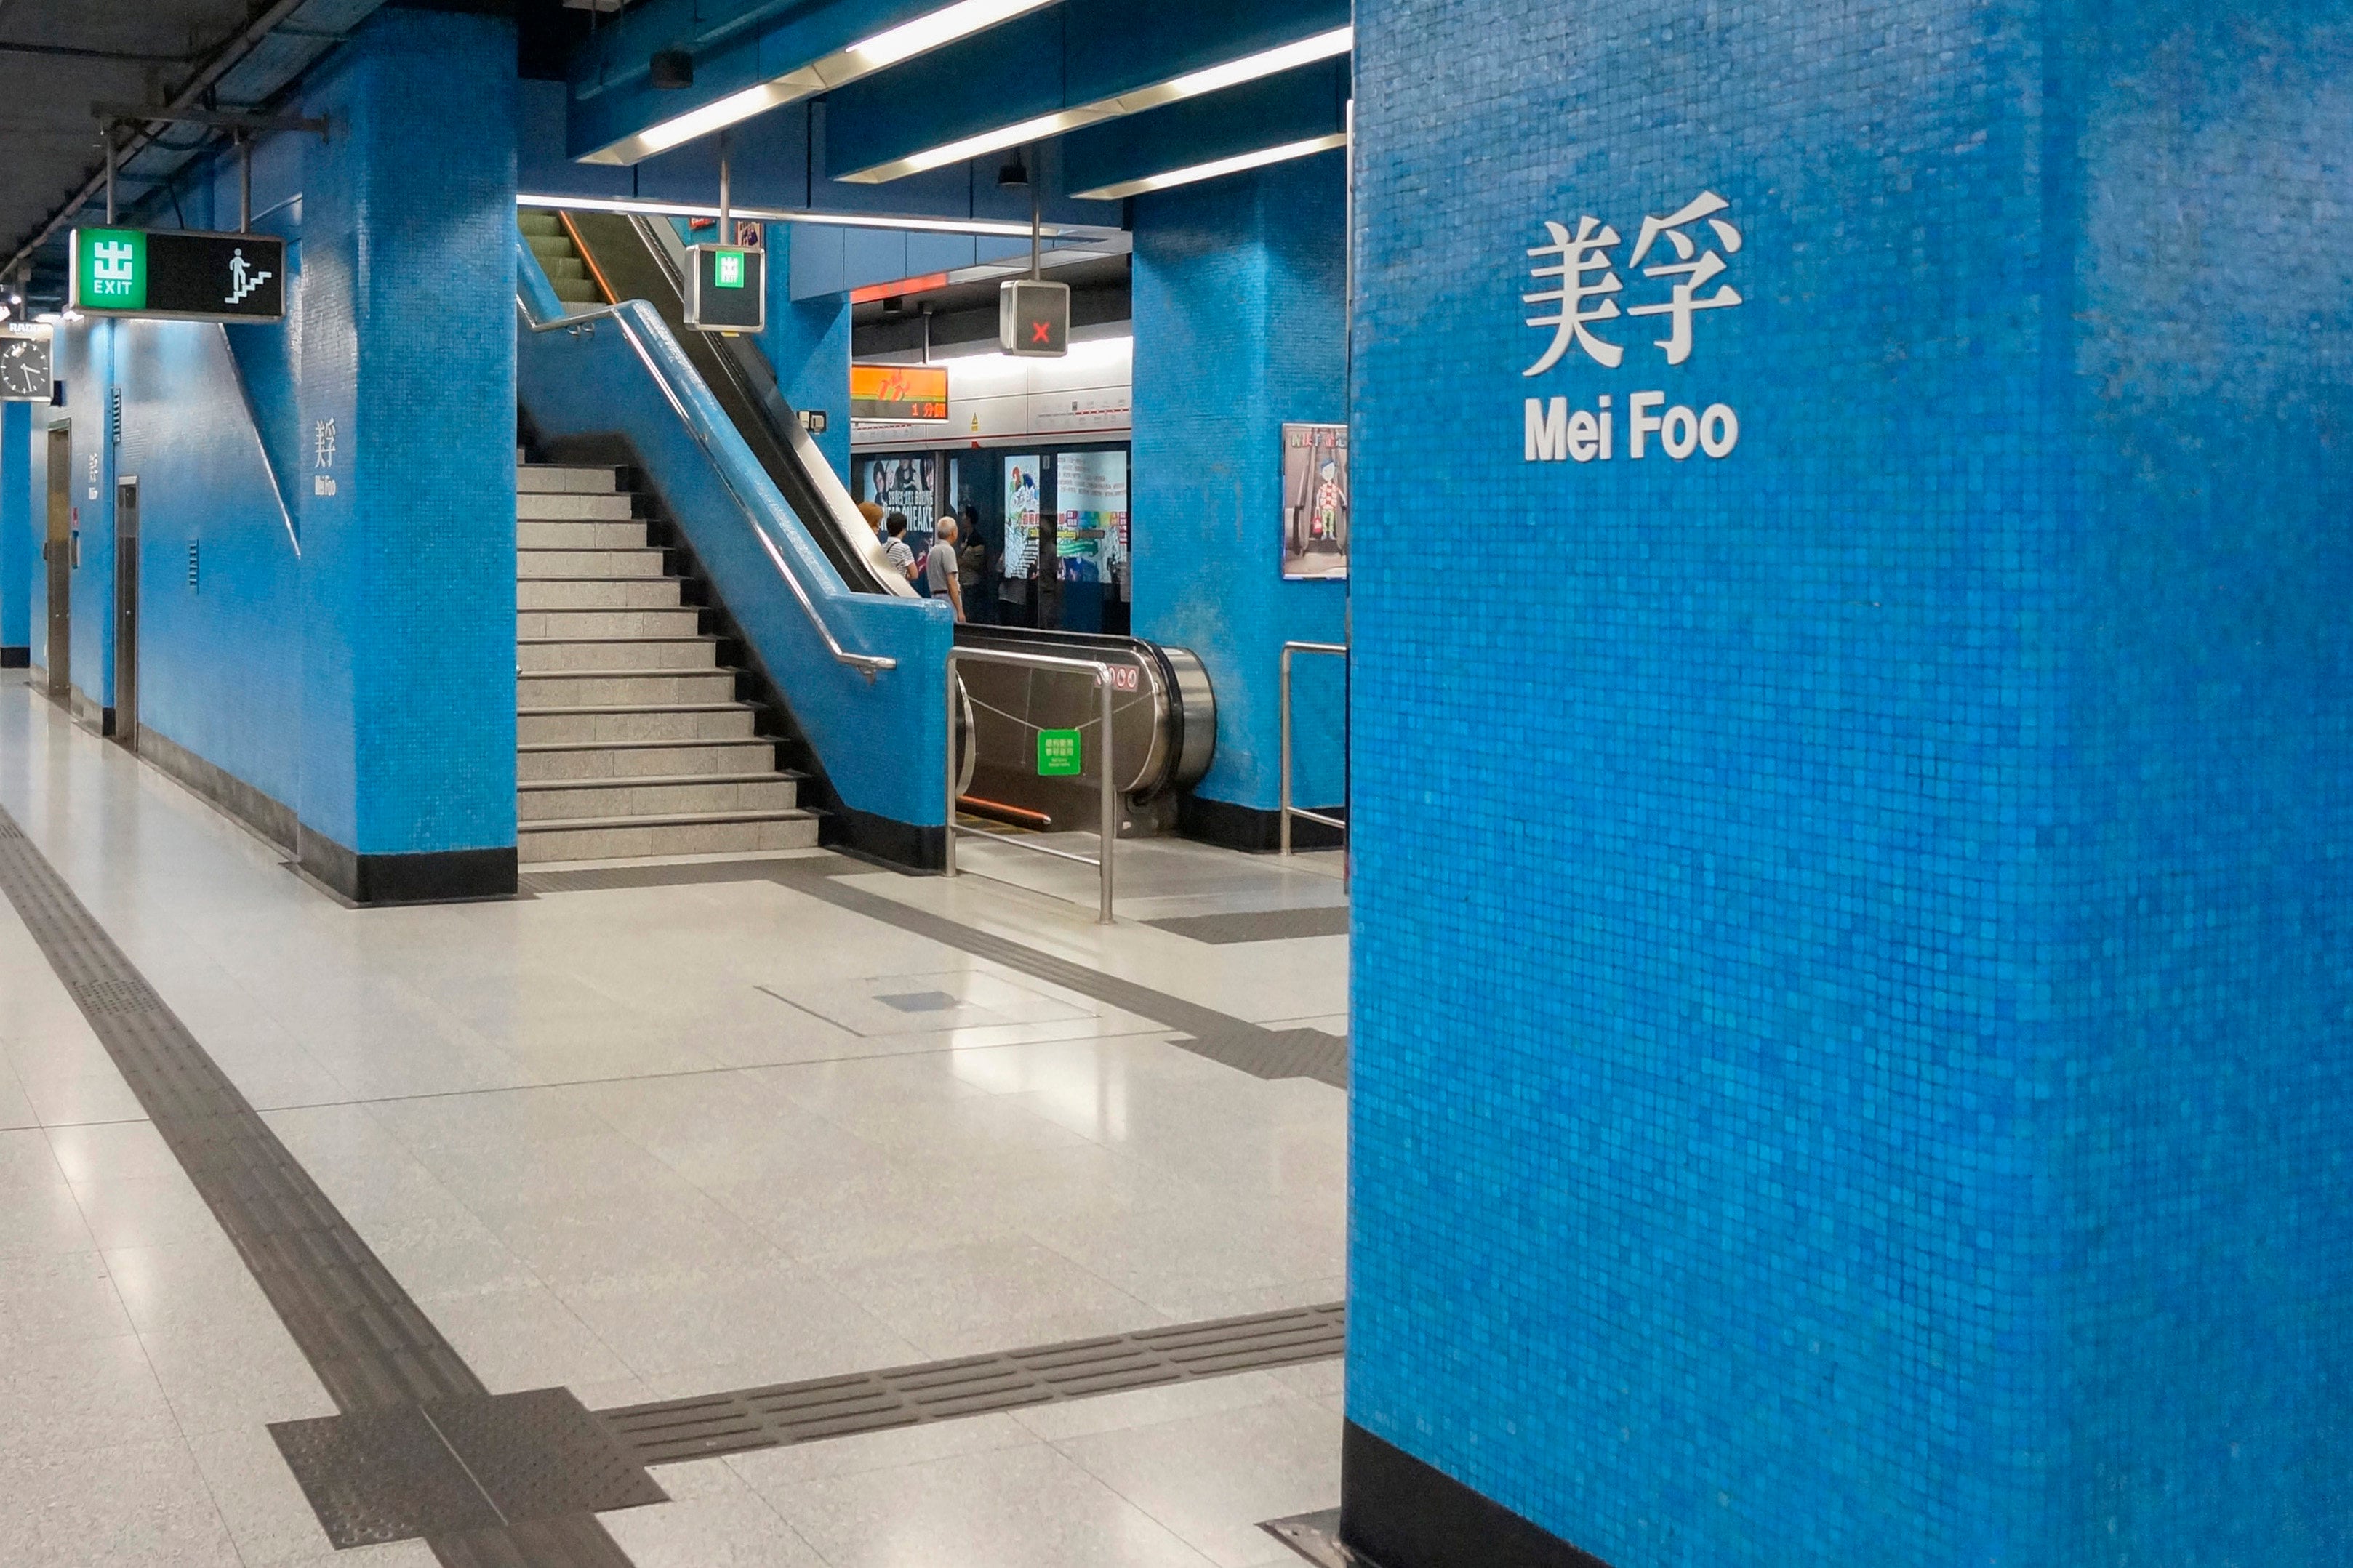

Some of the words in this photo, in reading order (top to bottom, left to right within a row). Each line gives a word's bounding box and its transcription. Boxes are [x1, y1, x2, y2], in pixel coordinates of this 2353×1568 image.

[94, 241, 132, 280] 出
[1522, 190, 1743, 377] 美孚
[94, 279, 132, 294] EXIT
[314, 417, 336, 468] 美孚
[1525, 395, 1611, 462] Mei
[1630, 390, 1739, 459] Foo
